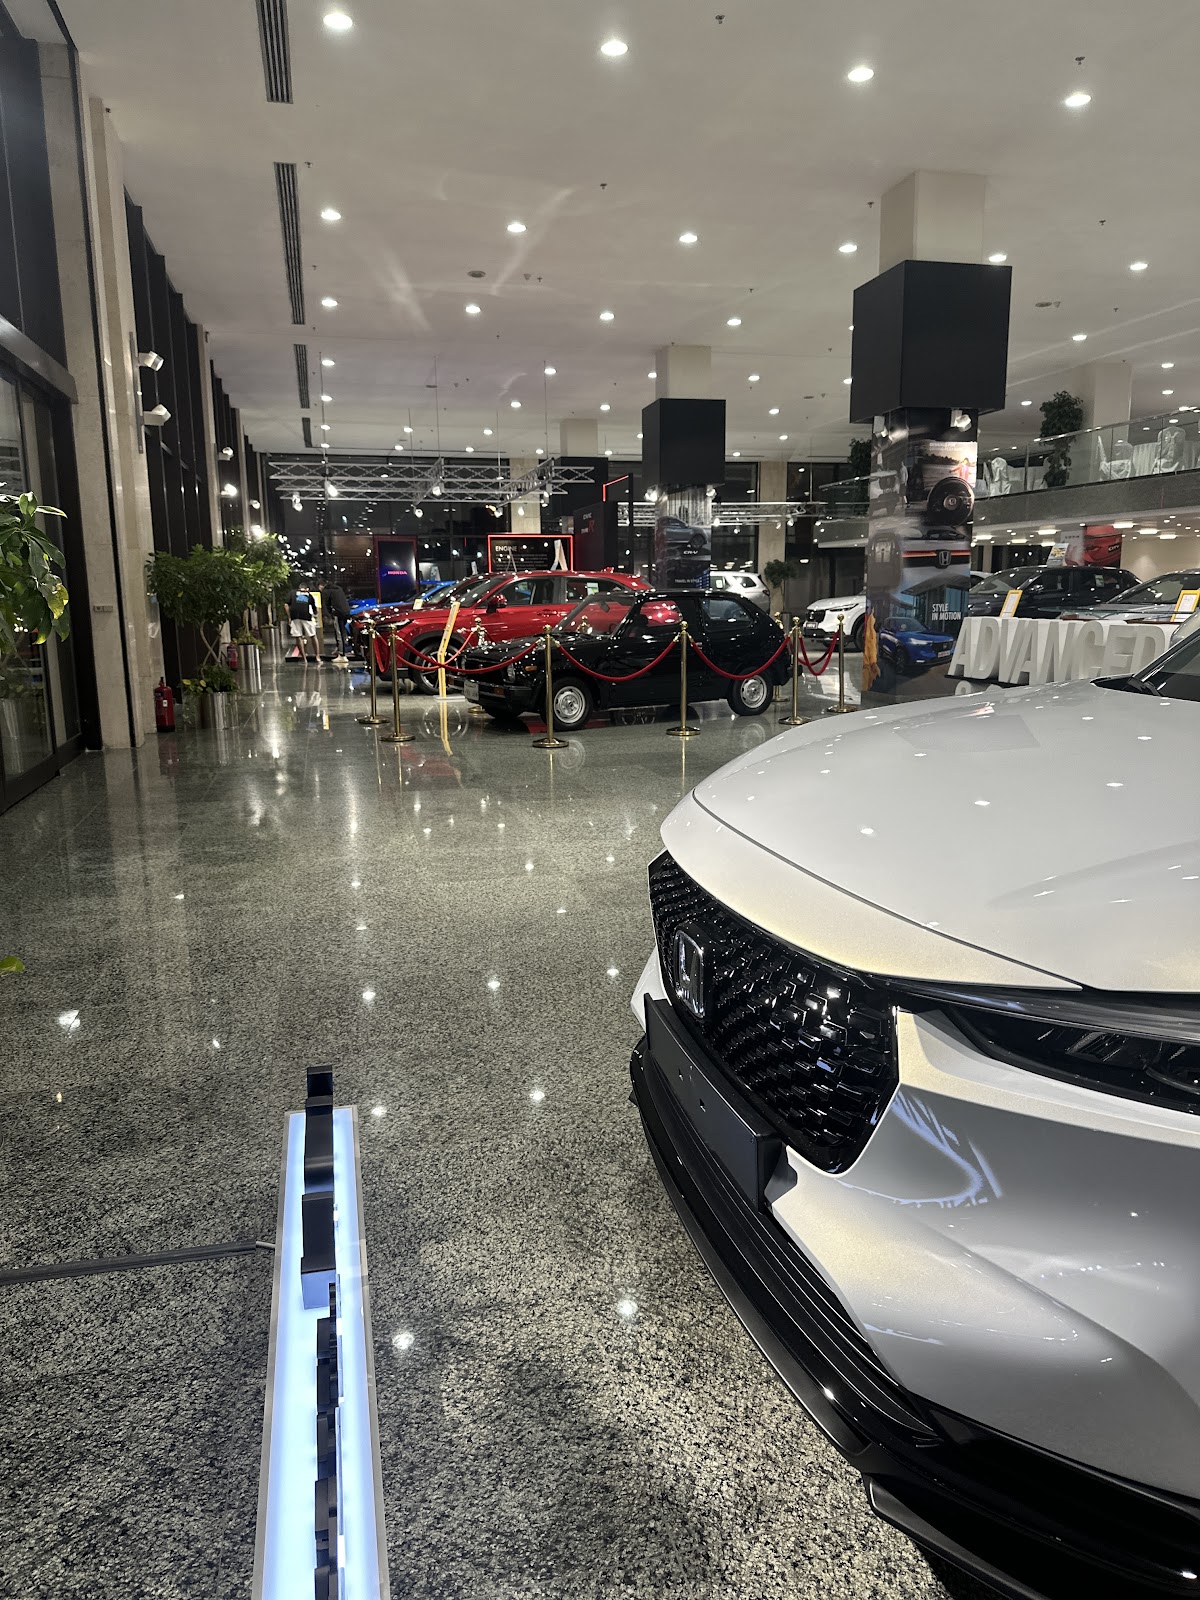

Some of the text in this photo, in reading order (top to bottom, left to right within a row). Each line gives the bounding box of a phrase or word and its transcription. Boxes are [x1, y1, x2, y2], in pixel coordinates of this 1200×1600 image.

[932, 603, 949, 612] STYLE
[931, 611, 962, 621] IN MOTION
[947, 616, 1166, 686] ADVANCED
